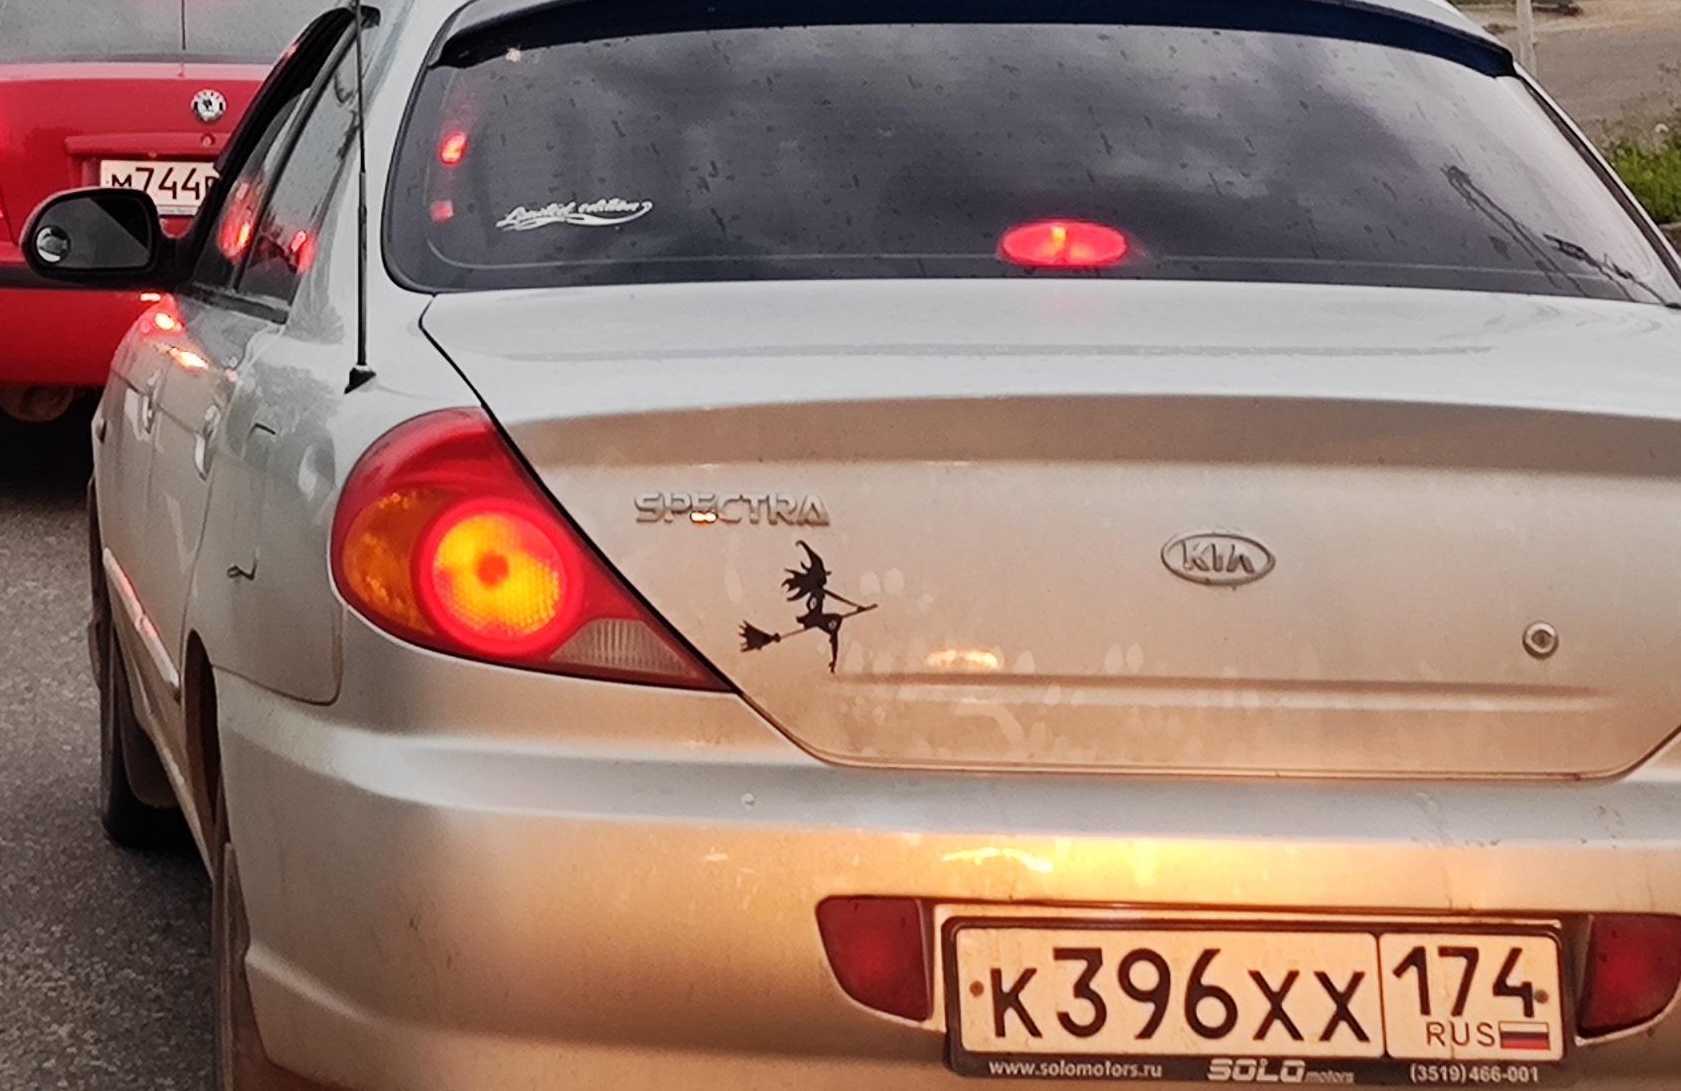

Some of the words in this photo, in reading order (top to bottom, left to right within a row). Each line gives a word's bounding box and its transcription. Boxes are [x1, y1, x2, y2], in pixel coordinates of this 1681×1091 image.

[633, 491, 830, 527] SPECTRA
[1179, 539, 1256, 575] KIA
[1392, 945, 1535, 1019] 174
[1425, 1020, 1495, 1048] RUS
[988, 1059, 1163, 1078] www.solomotors.ru
